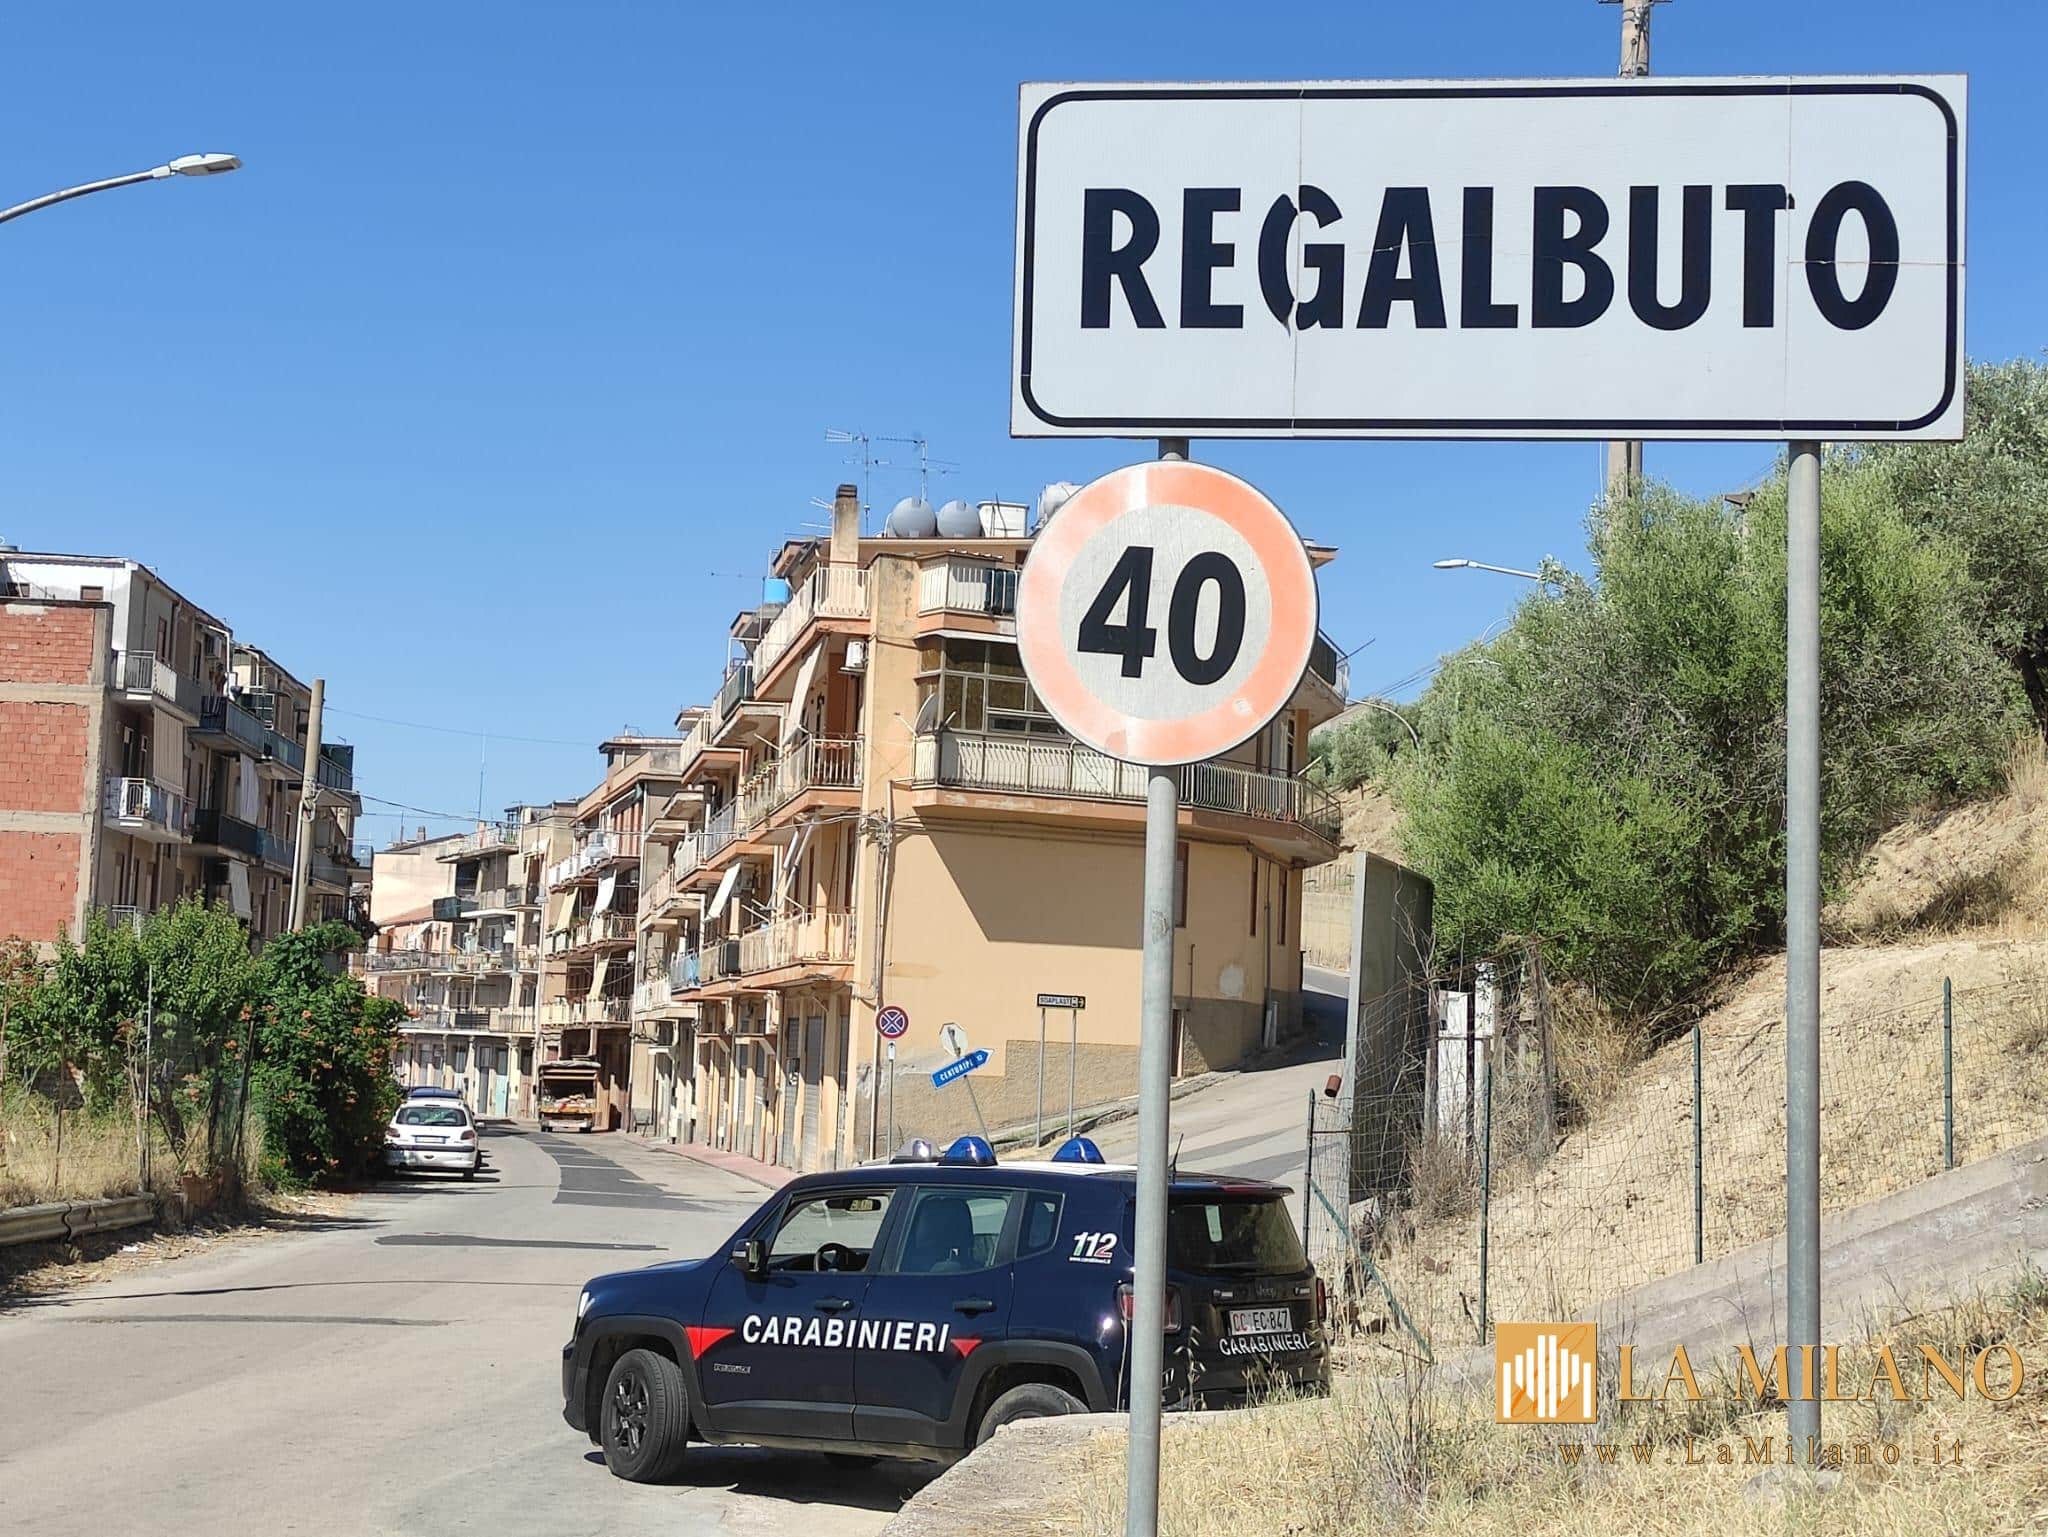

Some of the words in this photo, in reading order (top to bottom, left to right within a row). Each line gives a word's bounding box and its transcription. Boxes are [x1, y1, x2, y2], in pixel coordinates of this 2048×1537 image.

[1081, 181, 1900, 332] REGALBUTO
[1076, 546, 1246, 686] 40
[1073, 1231, 1118, 1258] 112
[742, 1314, 949, 1352] CARABINIERI
[1232, 1313, 1248, 1332] CC
[1219, 1331, 1310, 1356] CARABINIERI
